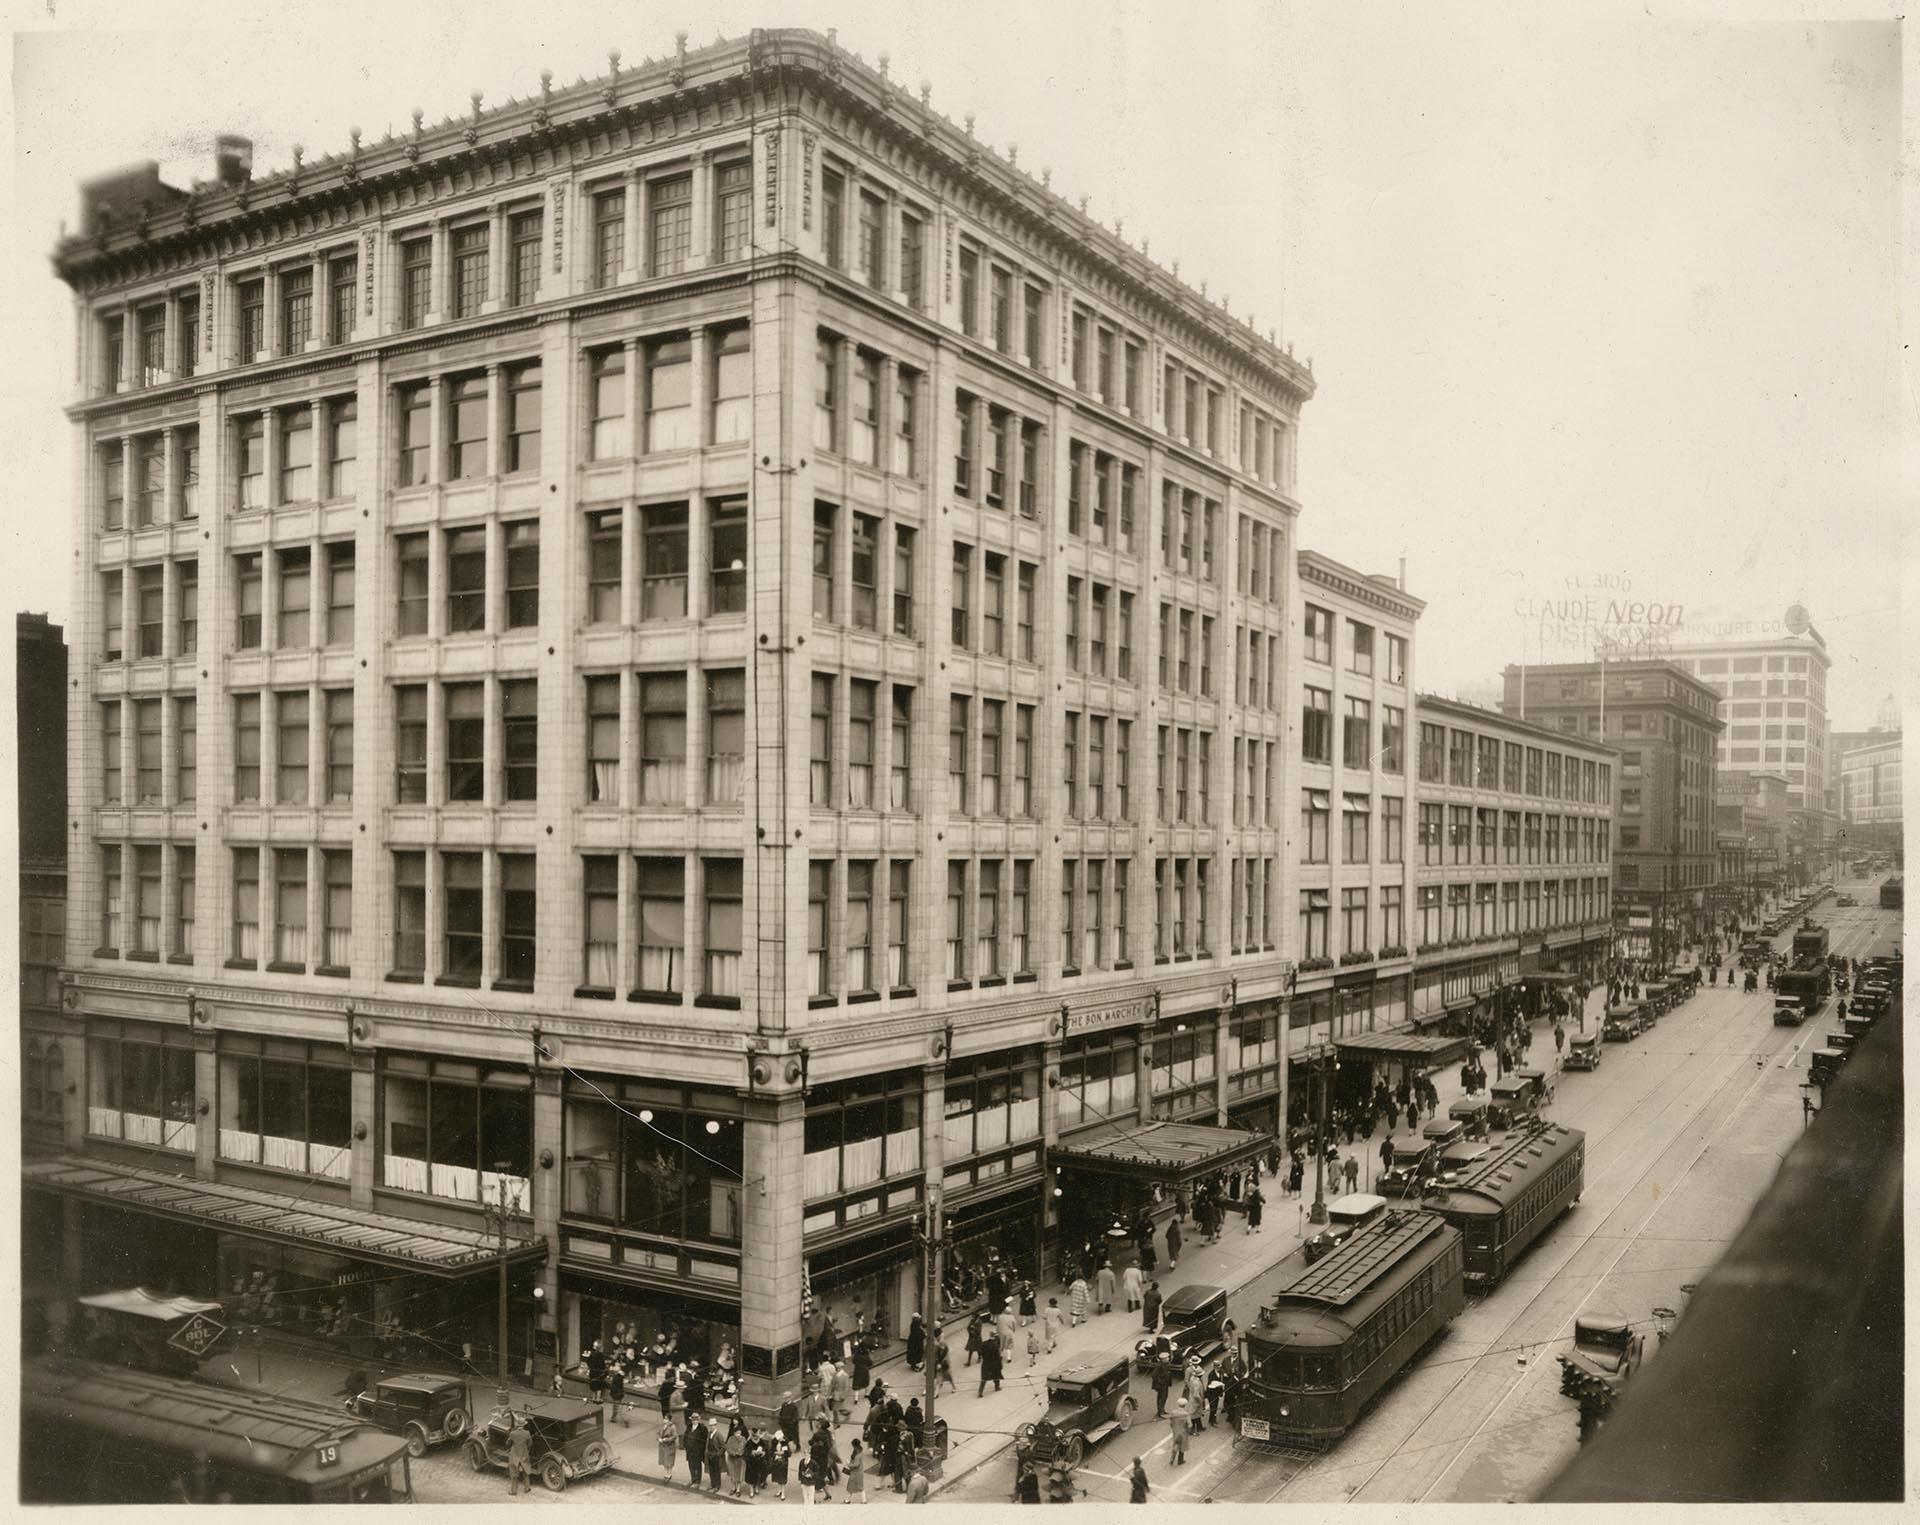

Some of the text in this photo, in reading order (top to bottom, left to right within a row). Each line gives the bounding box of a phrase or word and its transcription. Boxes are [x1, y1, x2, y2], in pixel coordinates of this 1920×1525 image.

[1514, 597, 1685, 625] CLAUDE Neon
[1085, 1012, 1103, 1025] BON
[319, 1446, 337, 1464] 19
